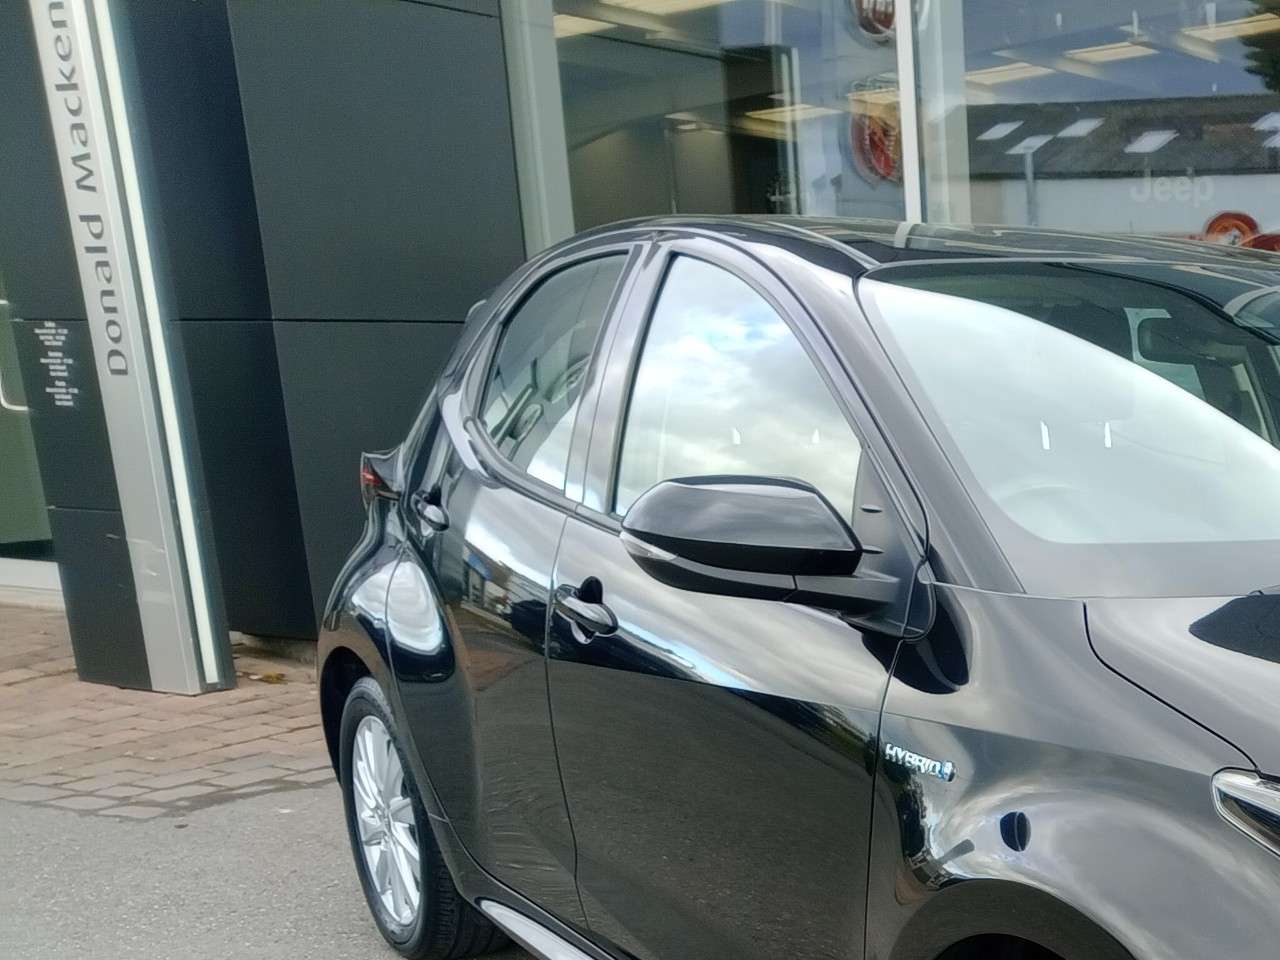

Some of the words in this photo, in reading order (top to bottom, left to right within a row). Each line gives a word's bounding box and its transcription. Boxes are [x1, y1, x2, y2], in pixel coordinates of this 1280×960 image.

[1130, 168, 1215, 208] Jeep
[78, 213, 129, 377] Donald
[885, 743, 942, 776] HYBRID
